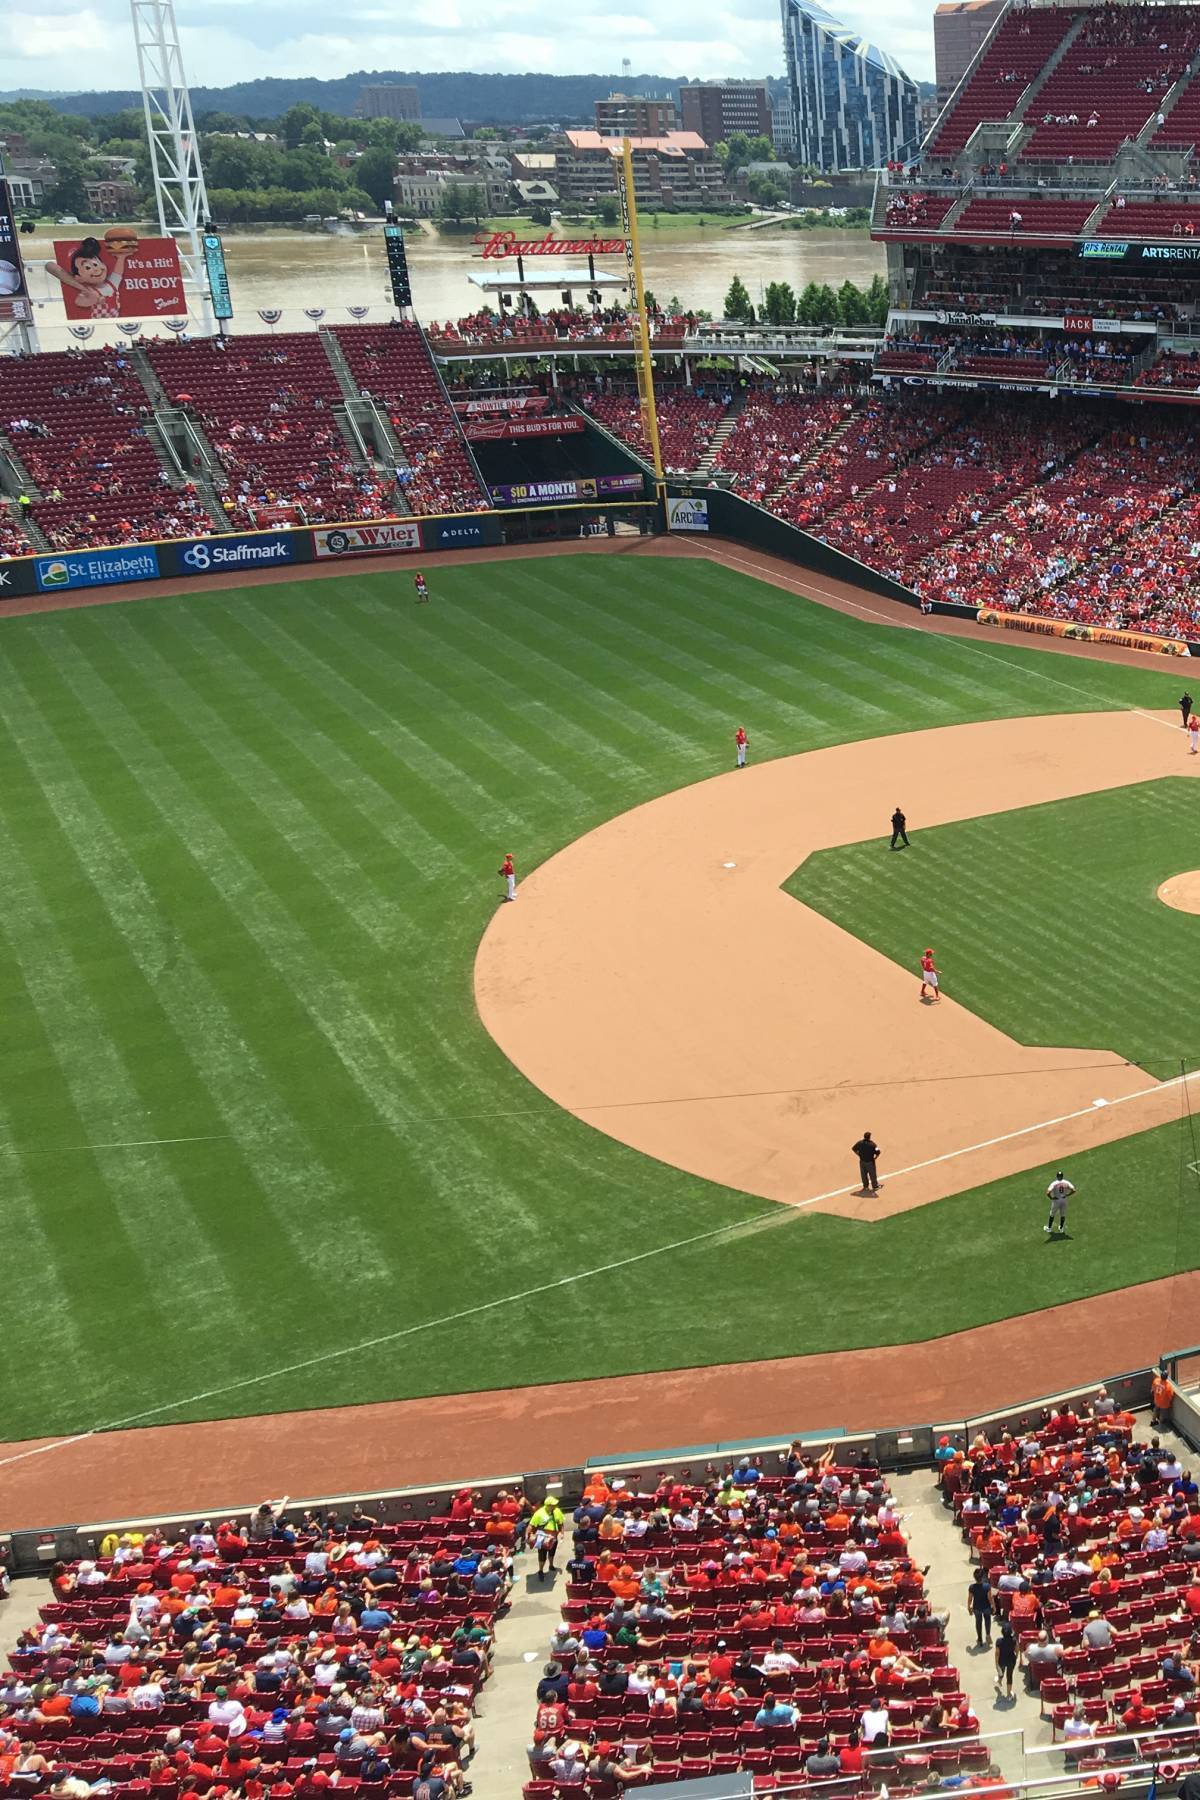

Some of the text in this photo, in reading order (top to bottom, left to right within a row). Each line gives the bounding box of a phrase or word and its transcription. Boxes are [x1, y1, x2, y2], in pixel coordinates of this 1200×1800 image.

[475, 231, 625, 259] Budweiser
[1101, 243, 1127, 253] RENTAL
[625, 239, 634, 267] WAY
[127, 257, 174, 269] It's a Hit!
[124, 277, 178, 290] BIG BOY
[948, 313, 996, 327] handlebar
[1064, 317, 1091, 330] JACK
[505, 399, 520, 410] BAR
[508, 424, 525, 434] THIS
[526, 423, 547, 433] BUD'S
[548, 422, 561, 430] FOR
[510, 486, 527, 498] $10
[529, 485, 537, 497] A
[537, 482, 577, 496] MONTH
[675, 512, 693, 524] ARC
[356, 528, 415, 545] Wyler
[451, 528, 480, 536] DELTA
[332, 537, 343, 548] 45
[212, 542, 287, 563] Staffmark
[89, 556, 154, 575] Elizabeth
[90, 567, 155, 580] HEALTHCARE
[1004, 618, 1035, 633] GORILLA
[1100, 632, 1154, 651] GORILLA TAPE
[539, 1714, 558, 1729] 69
